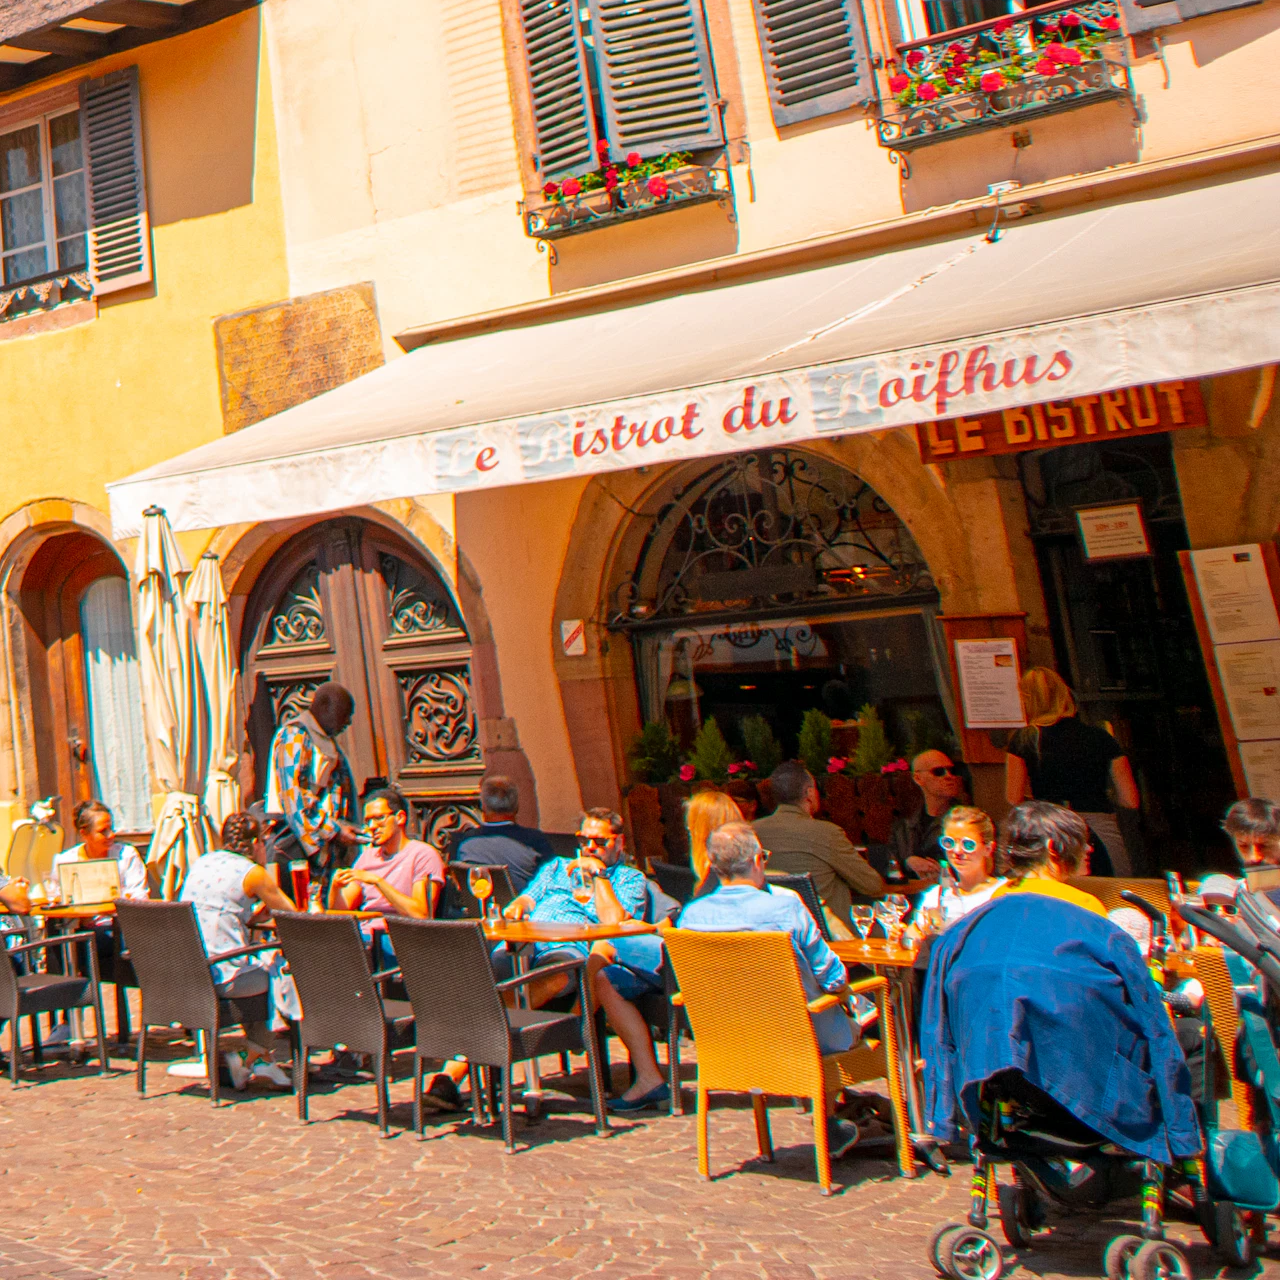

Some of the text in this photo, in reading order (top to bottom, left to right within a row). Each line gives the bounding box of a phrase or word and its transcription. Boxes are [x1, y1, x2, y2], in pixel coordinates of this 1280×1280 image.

[722, 385, 798, 434] du
[927, 381, 1185, 456] LE BISTROT
